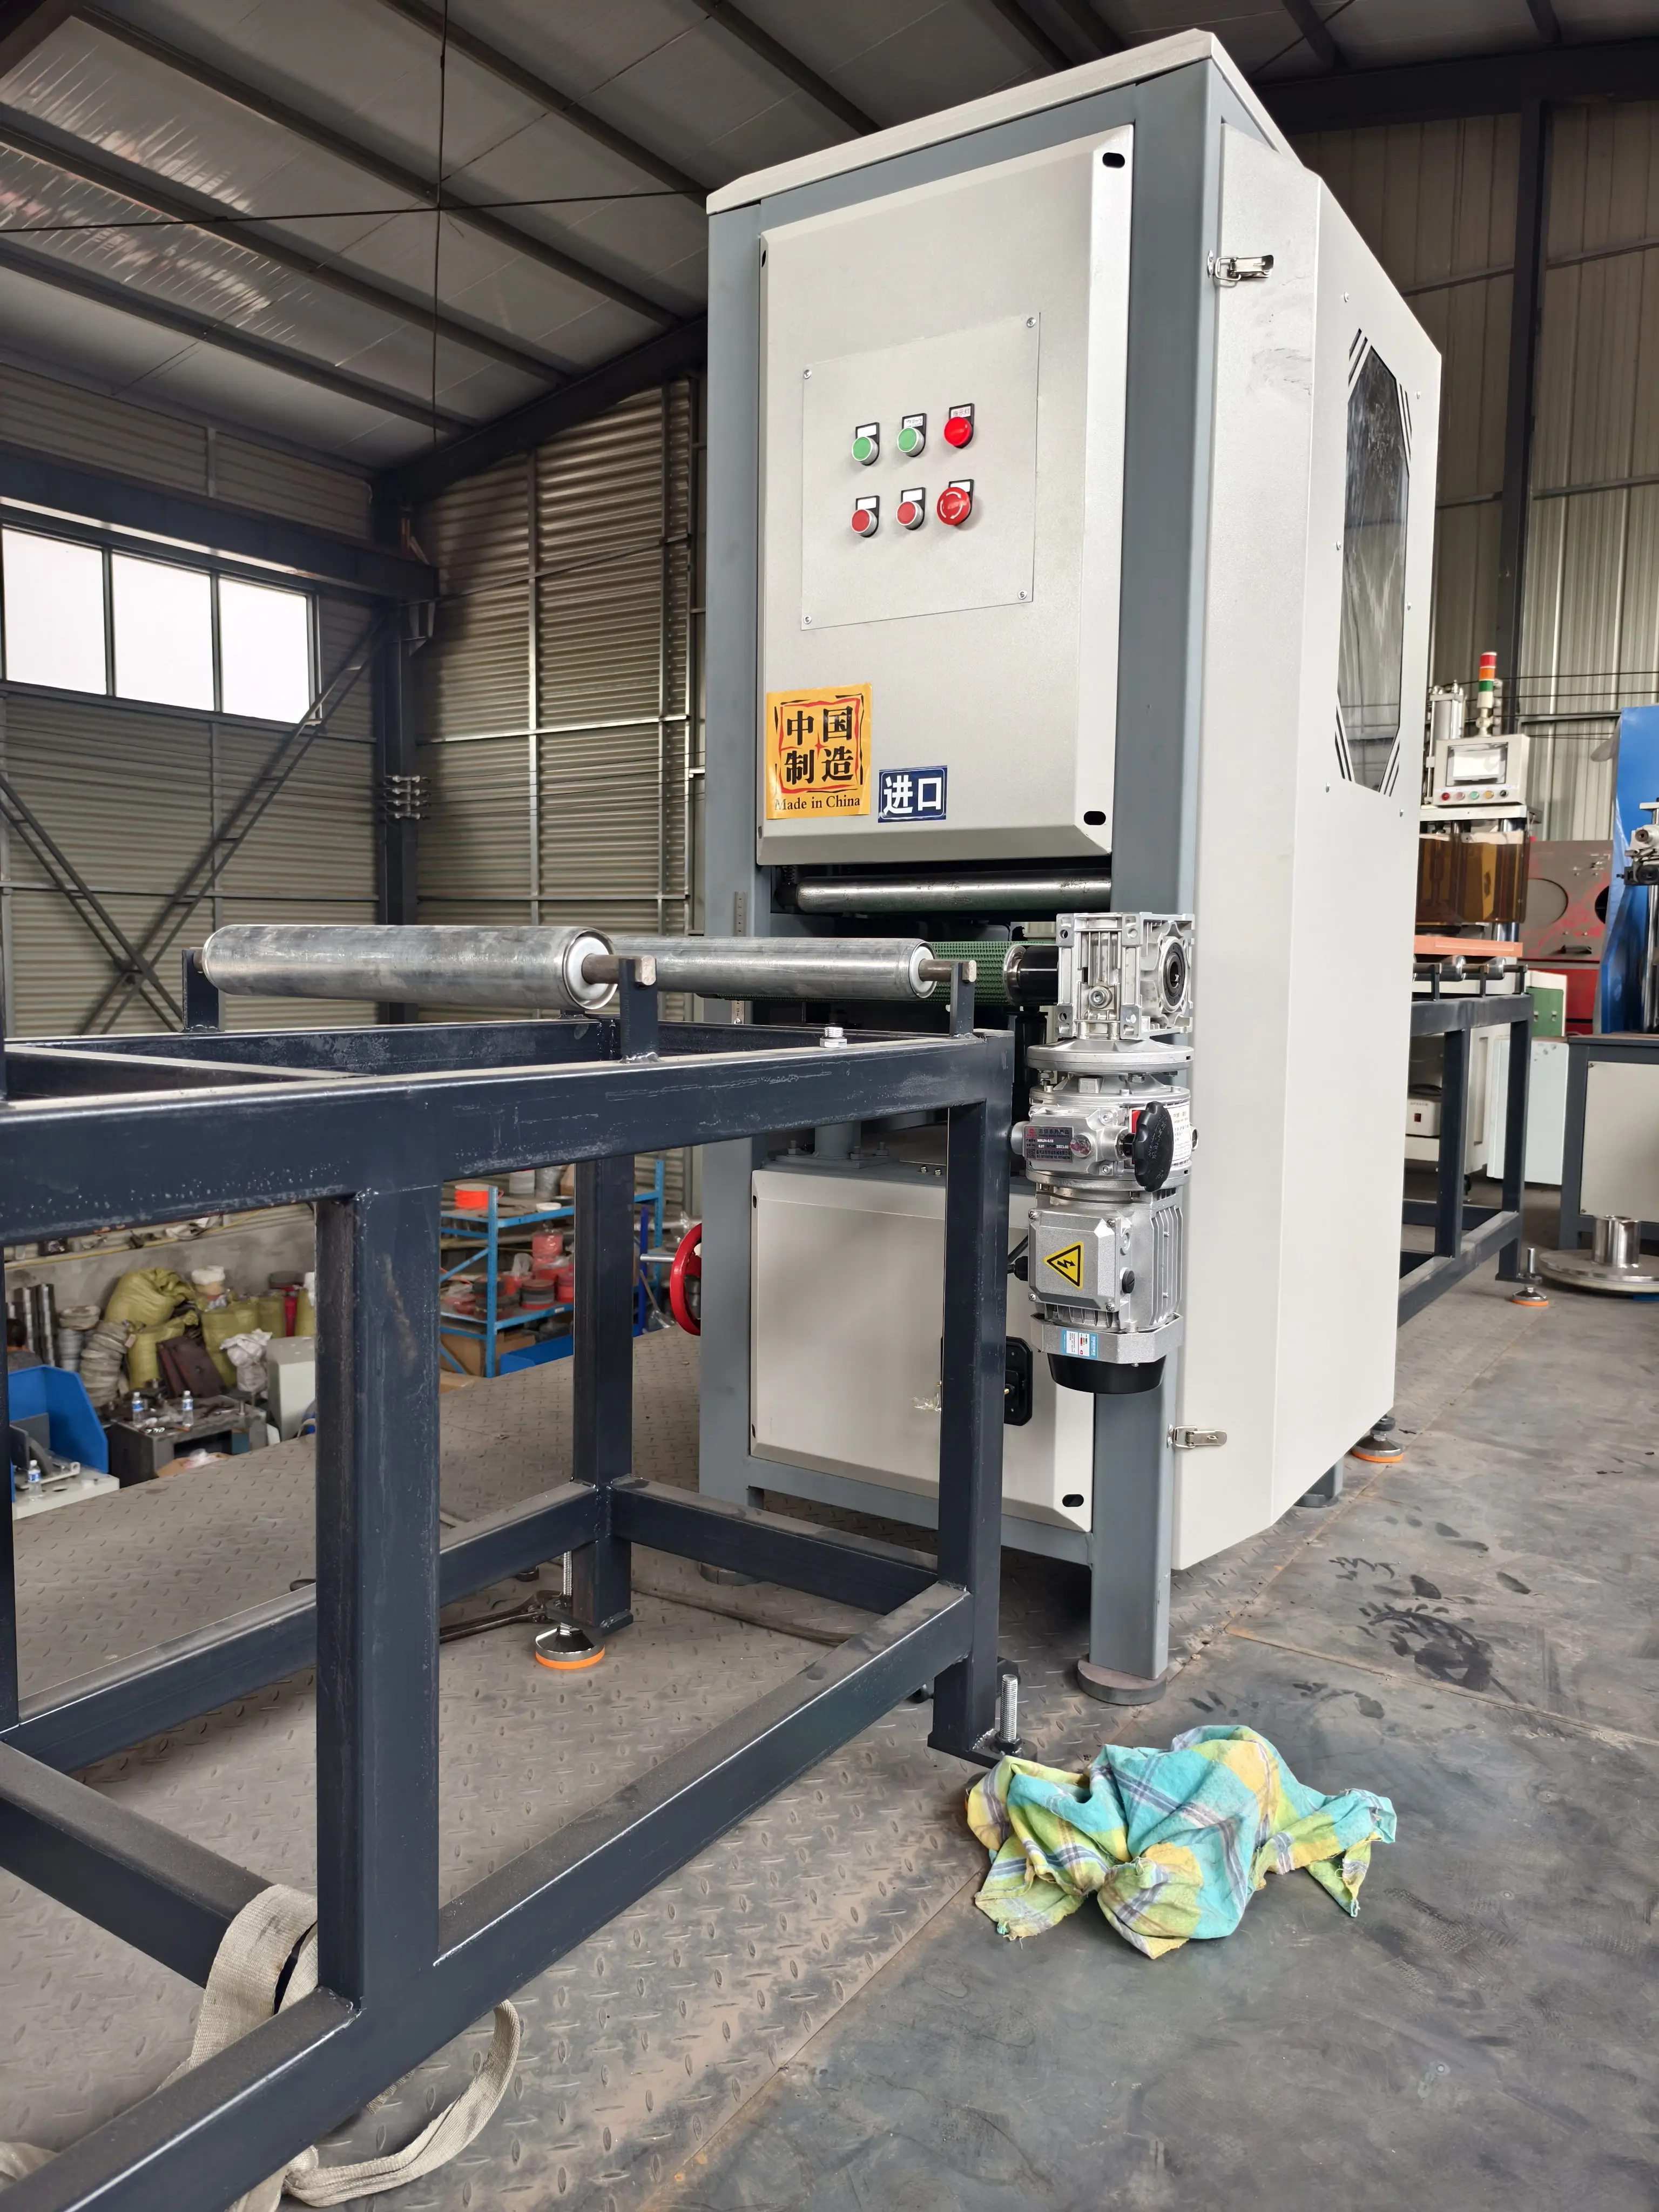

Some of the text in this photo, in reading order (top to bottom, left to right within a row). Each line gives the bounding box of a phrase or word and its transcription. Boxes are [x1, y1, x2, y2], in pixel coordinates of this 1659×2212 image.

[786, 706, 853, 746] 中国
[784, 746, 854, 785] 制造
[774, 794, 861, 811] Made in China
[883, 774, 942, 815] 进口
